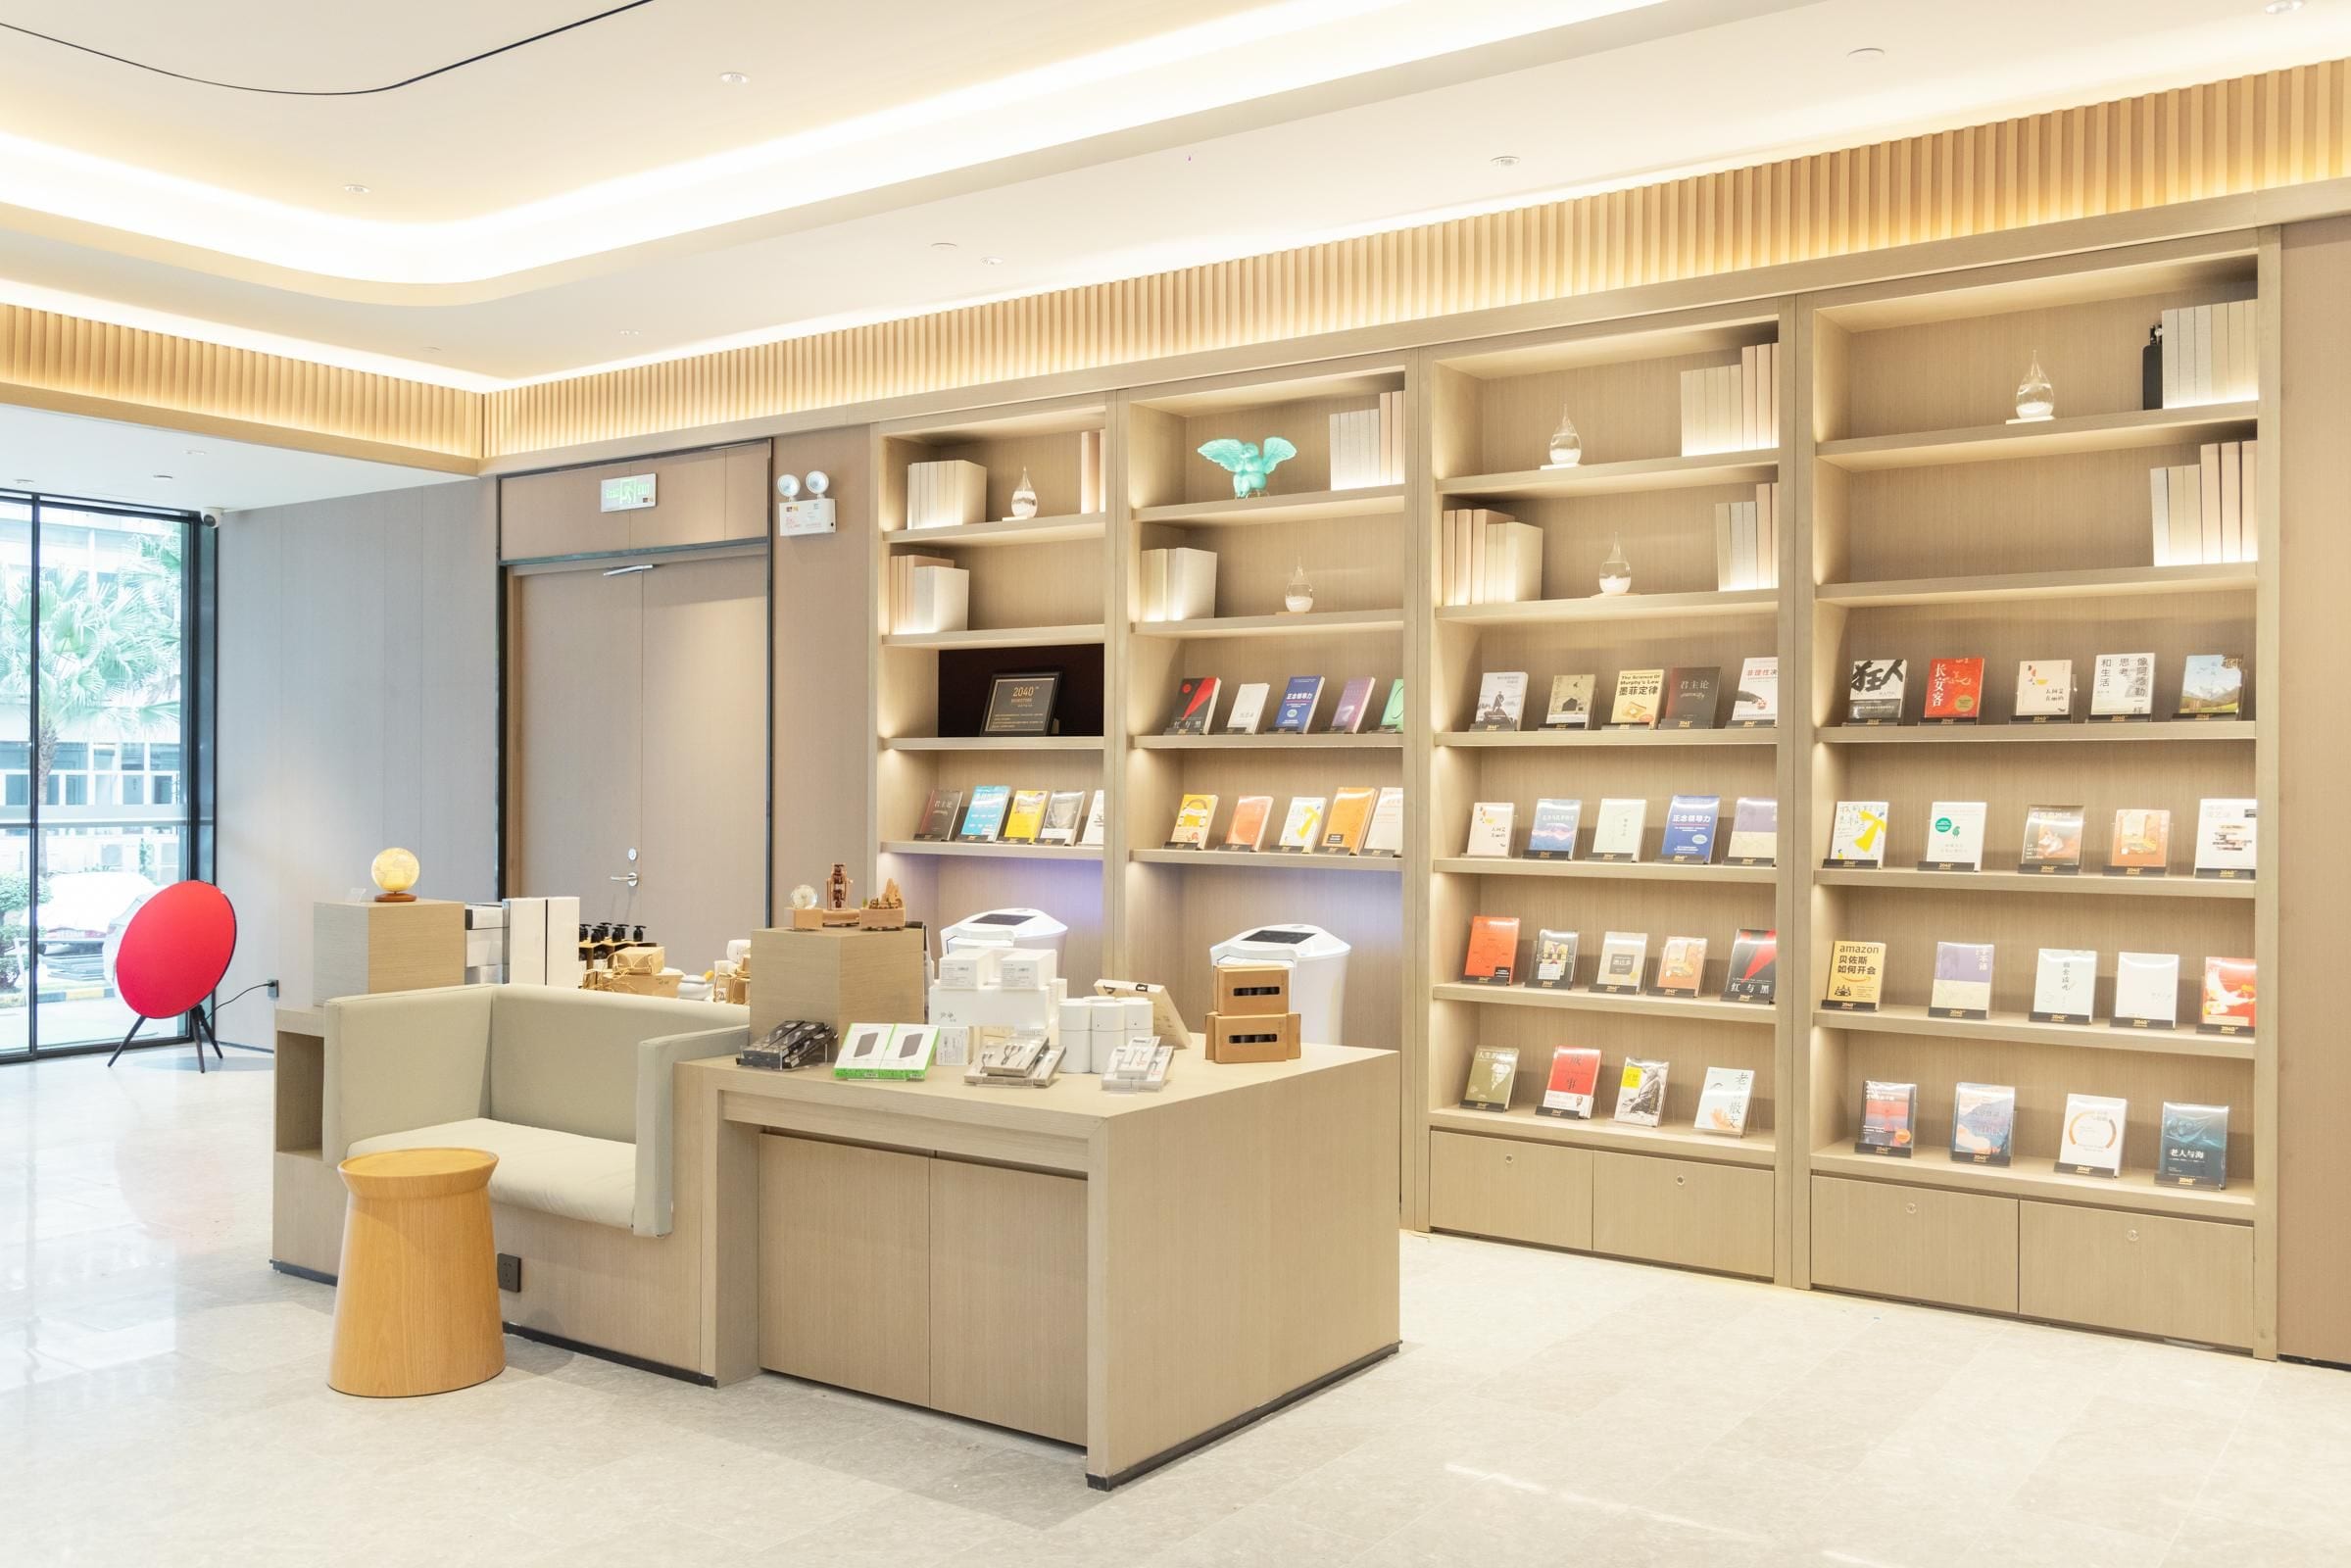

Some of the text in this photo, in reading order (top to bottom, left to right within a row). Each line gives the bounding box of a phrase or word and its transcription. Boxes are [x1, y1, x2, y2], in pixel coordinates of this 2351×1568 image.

[1851, 659, 1904, 692] 狂人
[2099, 659, 2112, 687] 和生活
[1618, 685, 1658, 696] 墨菲定律
[1680, 680, 1709, 690] 君主论
[1932, 663, 1947, 707] 长安客
[1012, 686, 1034, 697] 2040
[1673, 814, 1711, 823] 正念领导力
[1839, 944, 1880, 955] amazon
[1838, 956, 1868, 965] 贝佐斯
[1837, 965, 1877, 975] 如何开会
[1731, 983, 1770, 994] 红与黑
[2169, 1149, 2204, 1160] 老人与海
